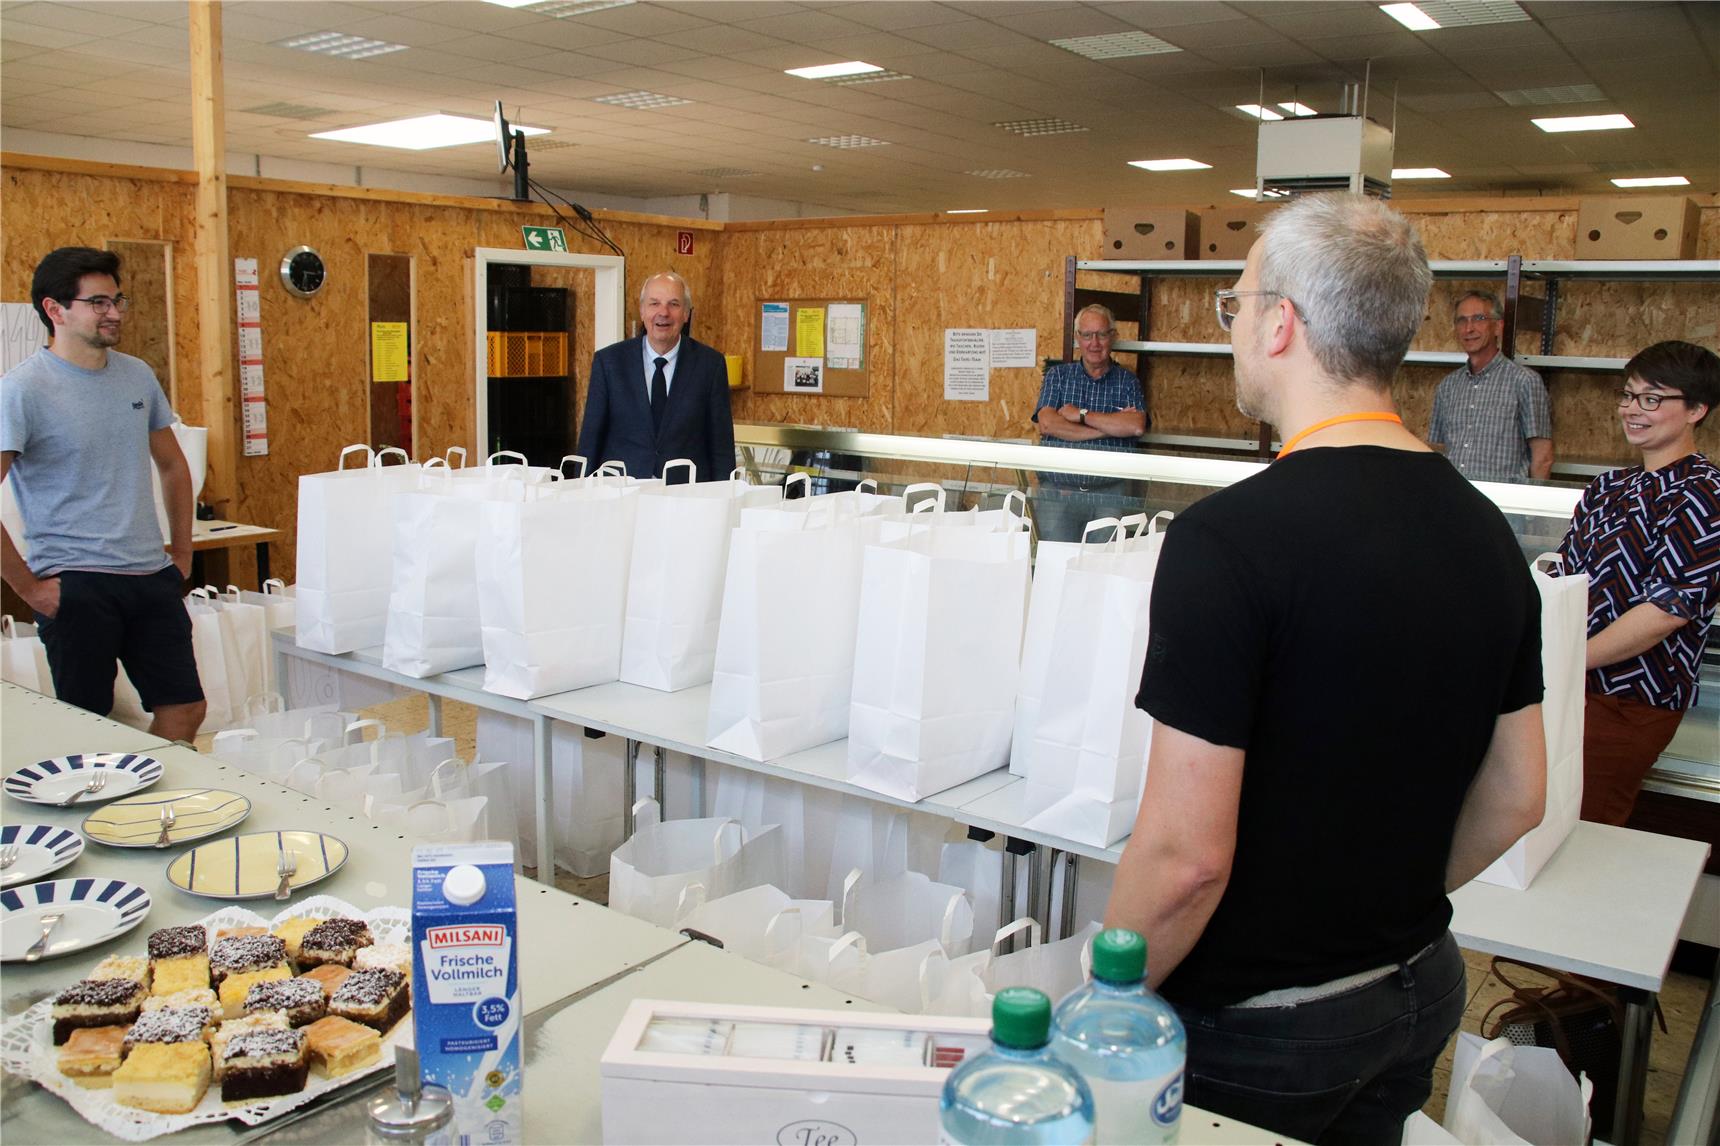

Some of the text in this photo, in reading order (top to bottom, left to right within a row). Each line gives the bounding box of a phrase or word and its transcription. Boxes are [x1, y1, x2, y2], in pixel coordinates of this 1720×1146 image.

[435, 930, 499, 945] MILSANI
[440, 954, 494, 967] Frische
[431, 966, 503, 981] Vollmilch
[481, 1004, 505, 1015] 3,5%
[484, 1013, 503, 1022] Fett
